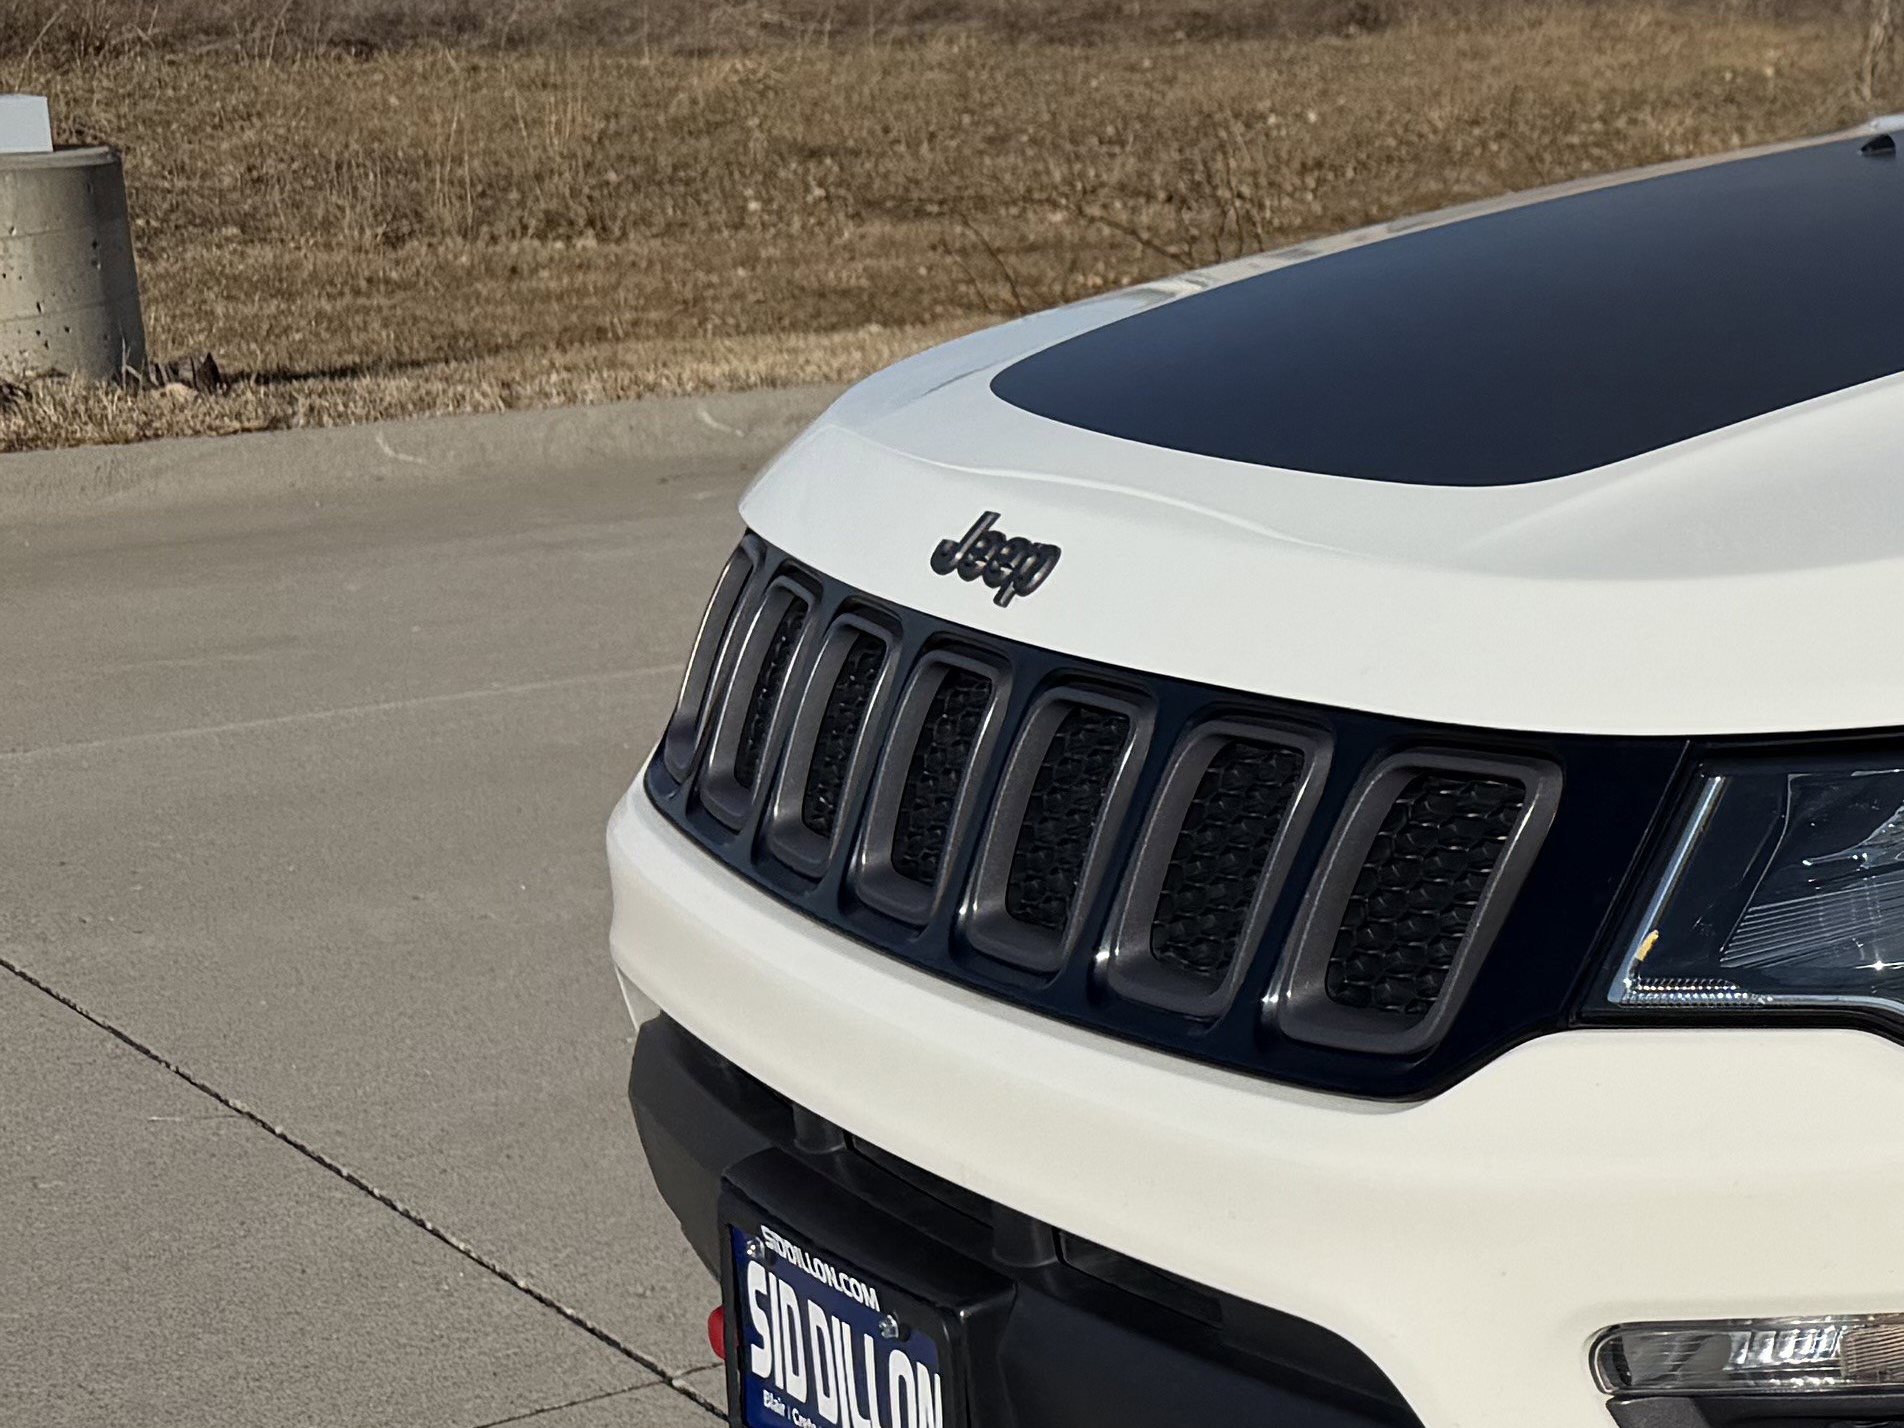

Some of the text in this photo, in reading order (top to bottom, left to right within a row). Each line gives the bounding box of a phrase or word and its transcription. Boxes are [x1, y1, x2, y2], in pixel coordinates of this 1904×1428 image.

[929, 510, 1062, 608] Jeep
[760, 1224, 880, 1311] SIDDILLON.COM
[746, 1260, 808, 1404] SID
